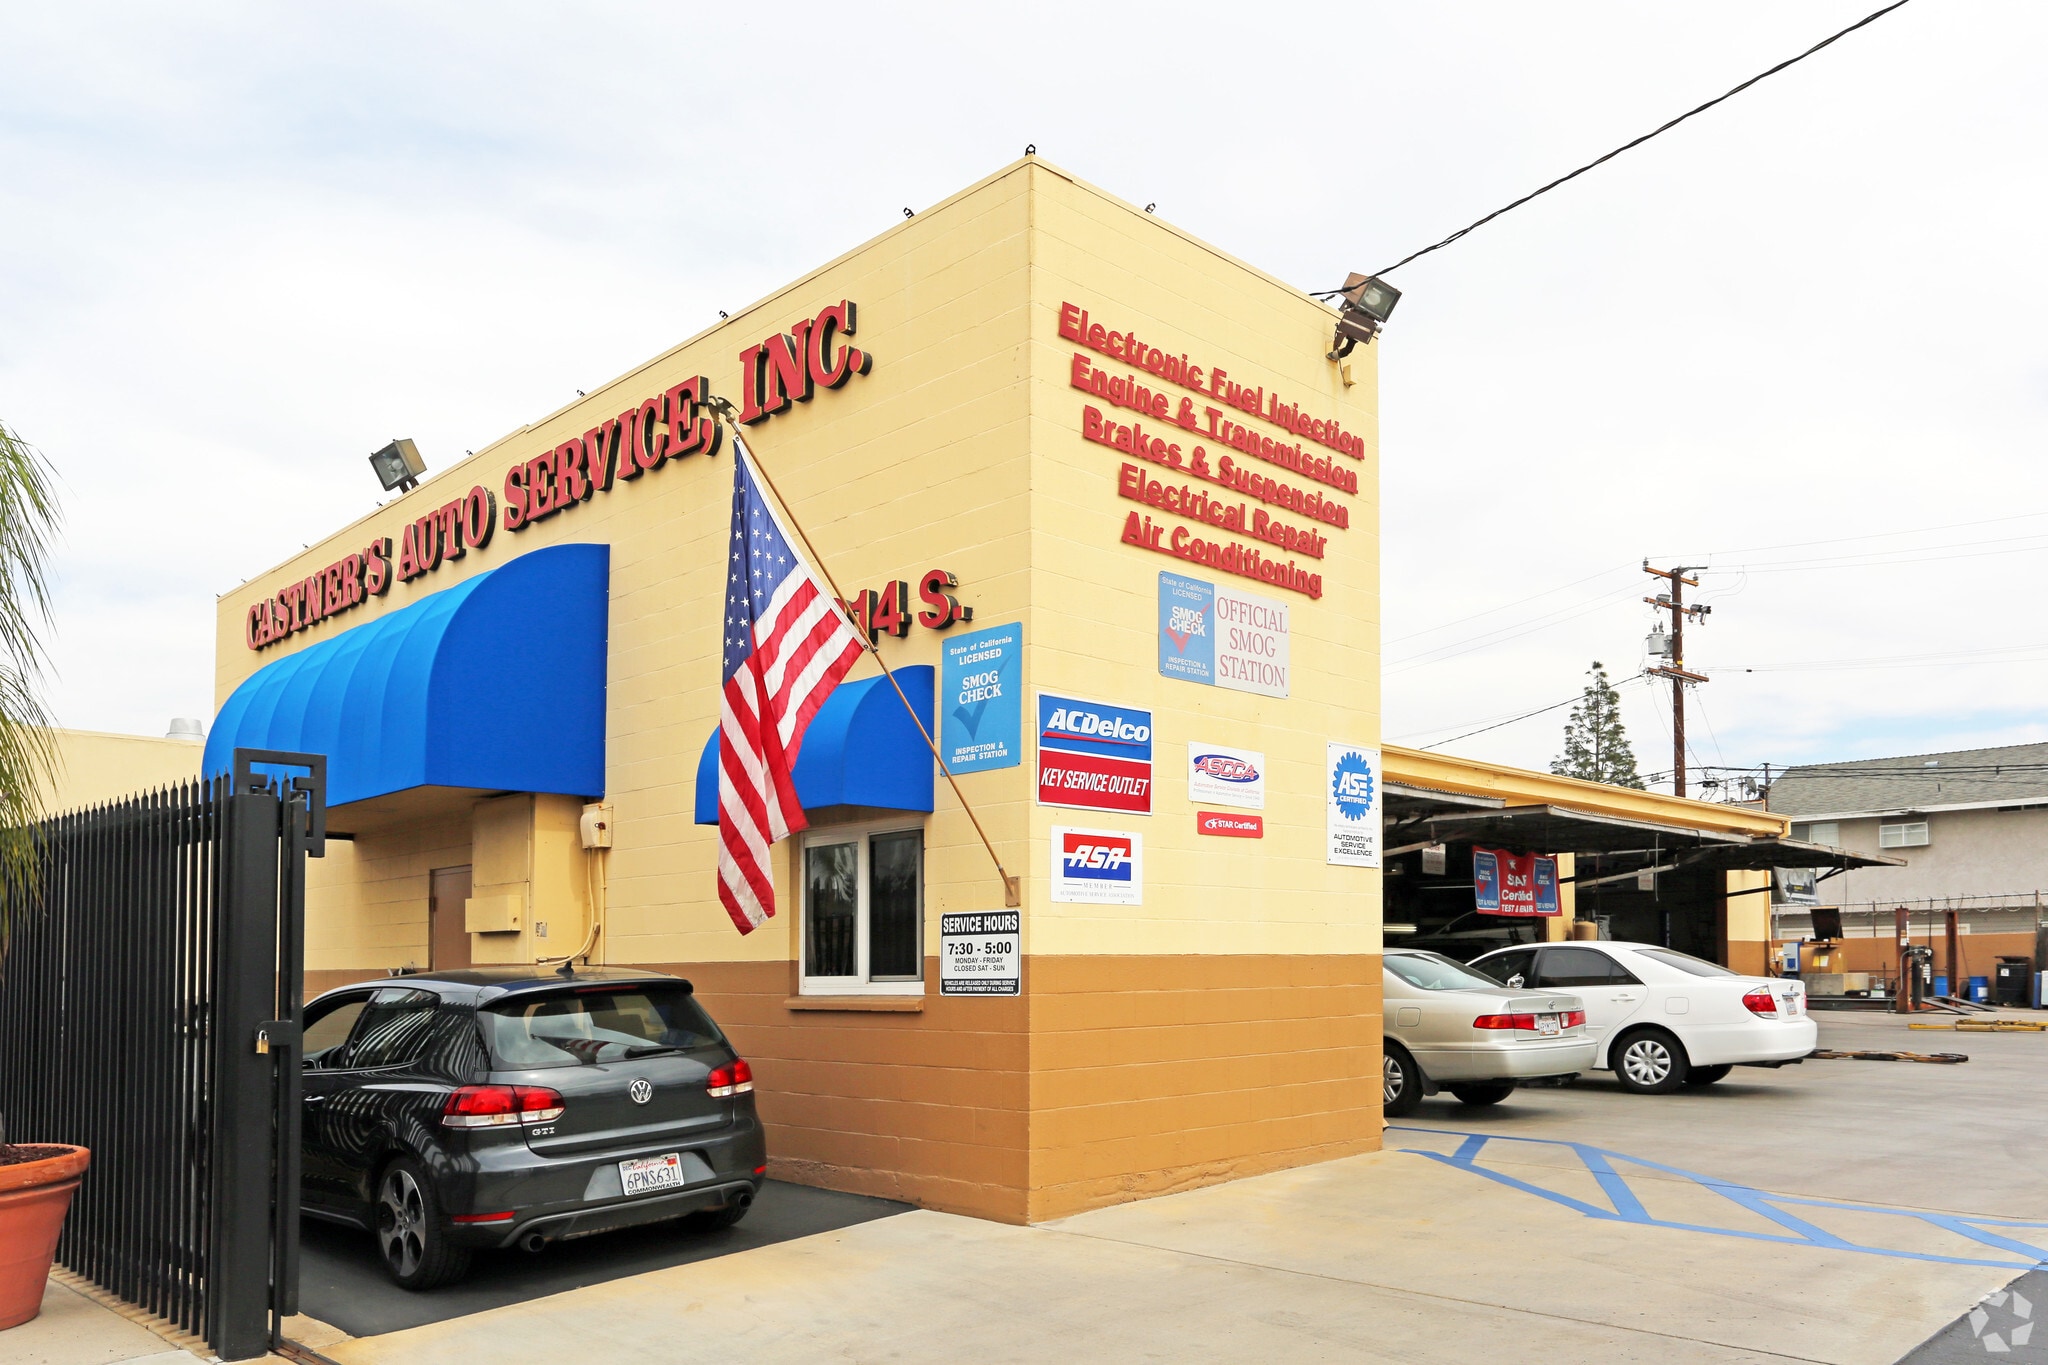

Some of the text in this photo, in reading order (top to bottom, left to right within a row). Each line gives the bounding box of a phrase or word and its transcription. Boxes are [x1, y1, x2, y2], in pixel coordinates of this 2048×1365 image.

[1059, 301, 1364, 460] Electronic Fuel Injection
[1071, 352, 1358, 494] Engine & Transmission
[246, 299, 872, 650] CASTNER'S AUTO SERVICE, INC.
[1083, 404, 1349, 529] Brakes & Suspension
[1119, 463, 1327, 559] Electrical Repair
[1122, 511, 1322, 599] Air Conditioning
[1162, 576, 1177, 586] State
[1186, 583, 1212, 595] California
[1173, 588, 1202, 600] LICENSED
[918, 569, 974, 629] S.
[1172, 606, 1202, 623] SMOG
[1217, 596, 1287, 634] OFFICIAL
[1170, 618, 1205, 636] CHECK
[970, 643, 977, 651] of
[980, 636, 1012, 648] California
[1230, 628, 1276, 657] SMOG
[959, 648, 1002, 665] LICENSED
[1168, 656, 1200, 668] INSPECTION
[1166, 662, 1209, 677] REPAIR STATION
[1220, 655, 1285, 688] STATION
[962, 670, 998, 690] SMOG
[959, 684, 1002, 704] CHECK
[1047, 708, 1149, 742] ACDelco
[952, 749, 1007, 763] REPAIR STATION
[956, 743, 995, 755] INSPECTION
[1194, 757, 1255, 780] ASCCA
[1041, 768, 1149, 796] KEY SERVICE OUTLET
[1338, 772, 1367, 797] ASE
[1340, 796, 1366, 804] CERTIFIED
[1218, 820, 1257, 830] STAR Certified
[1334, 834, 1373, 843] AUTOMOTIVE
[1341, 841, 1365, 849] SERVICE
[1068, 845, 1126, 869] ASA
[1334, 848, 1372, 856] EXCELLENCE
[943, 915, 1017, 933] SERVICE HOURS
[948, 943, 973, 955] 7:30
[985, 942, 1011, 954] 5:00
[532, 1127, 555, 1135] GTI
[633, 1160, 664, 1170] California
[627, 1167, 678, 1189] 6PNS631
[628, 1182, 680, 1194] COMMONWEALTH
